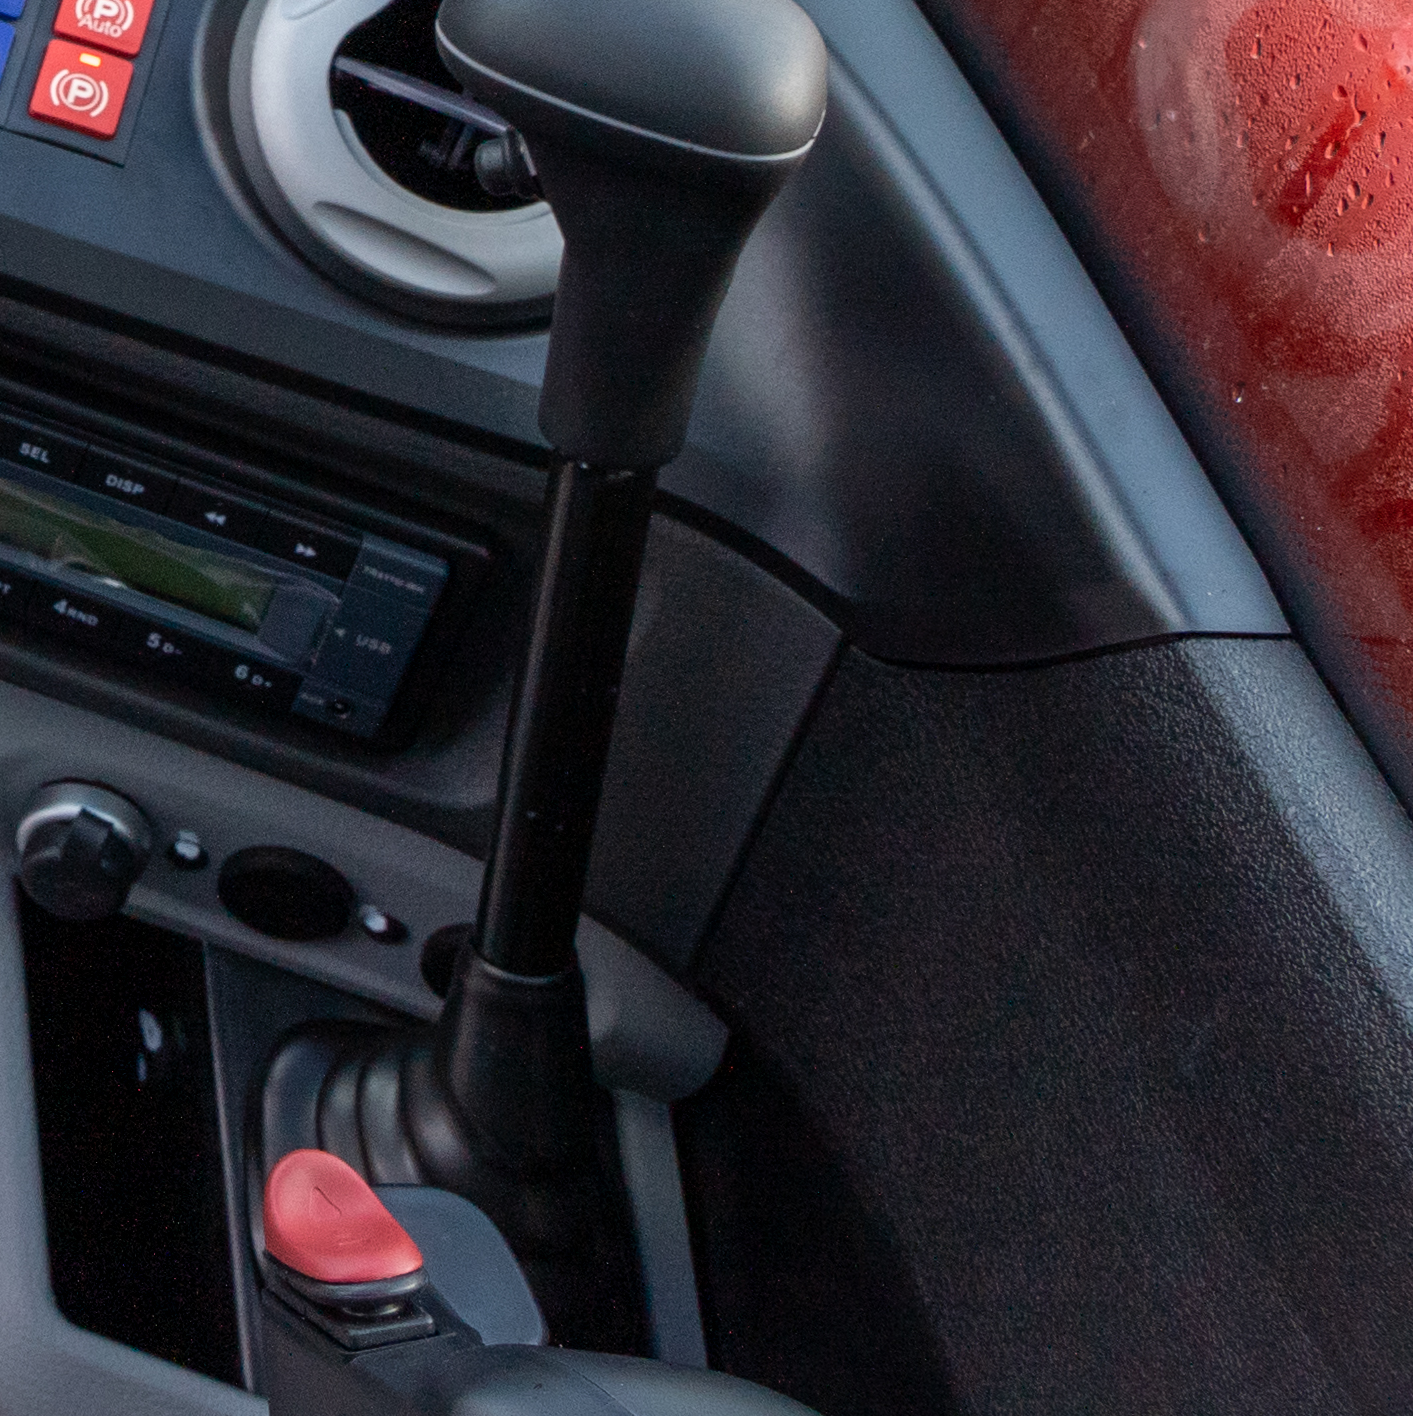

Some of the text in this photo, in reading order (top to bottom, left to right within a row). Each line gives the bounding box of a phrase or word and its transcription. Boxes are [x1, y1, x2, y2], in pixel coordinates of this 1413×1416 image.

[77, 13, 124, 38] Auto
[20, 442, 50, 464] SEL
[105, 474, 145, 495] DISP
[146, 632, 162, 649] 5
[235, 664, 250, 681] 6
